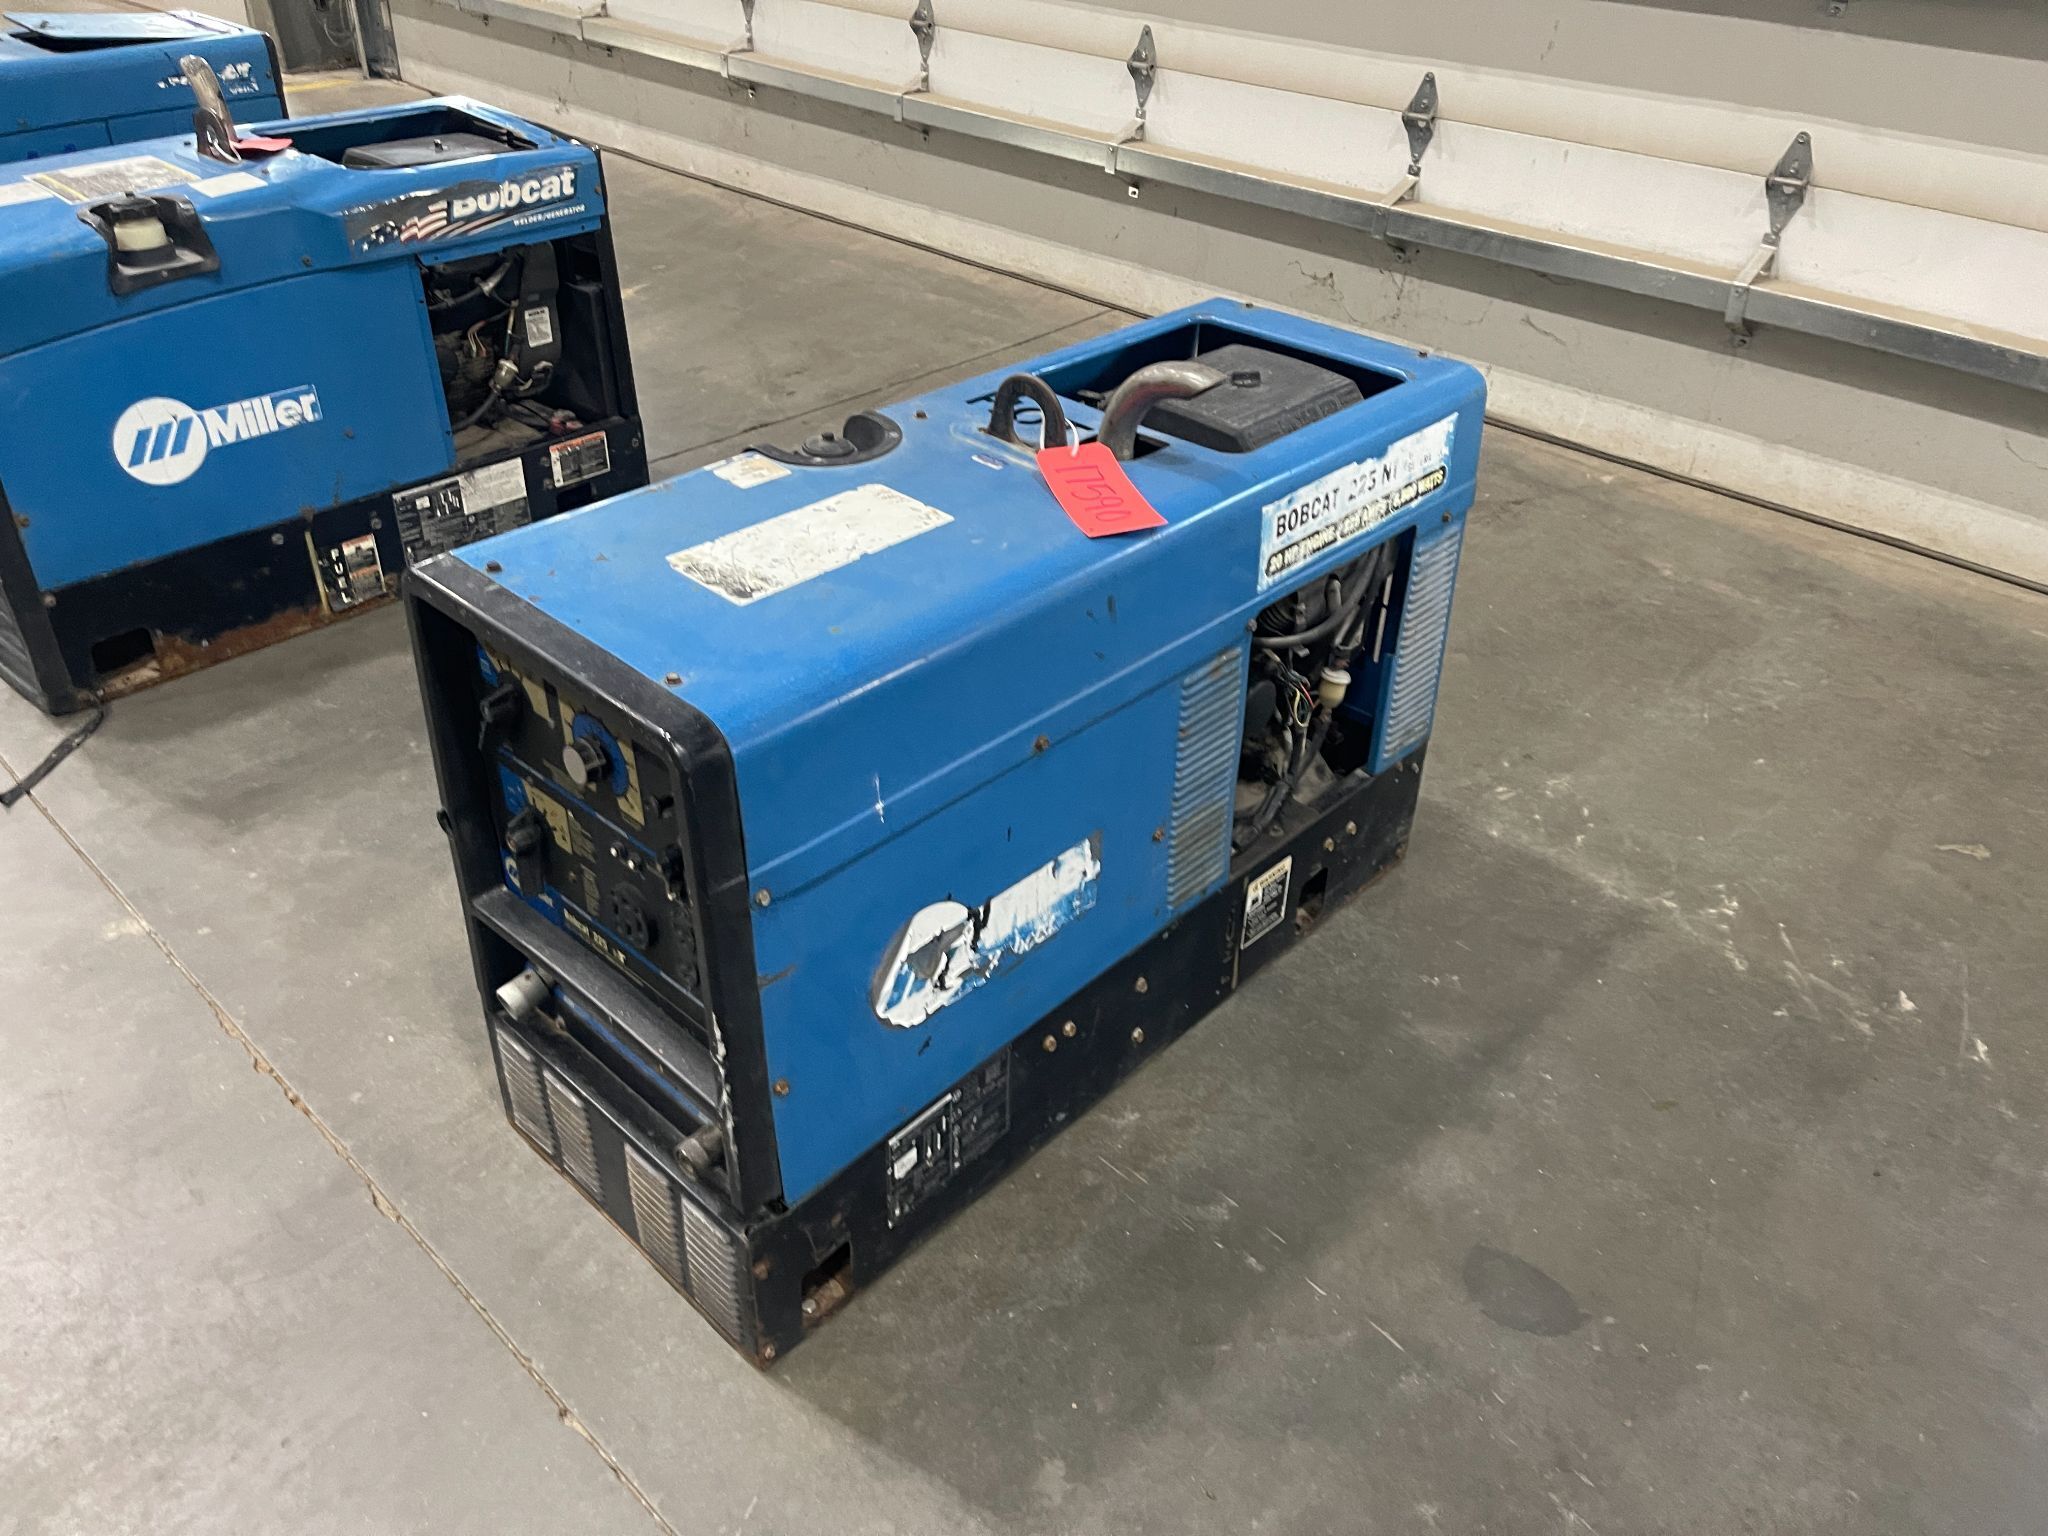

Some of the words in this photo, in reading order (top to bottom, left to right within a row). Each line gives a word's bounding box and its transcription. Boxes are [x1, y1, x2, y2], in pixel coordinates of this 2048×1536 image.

[452, 166, 575, 218] Bobcat
[203, 393, 316, 447] Miller
[1055, 465, 1131, 522] 17590
[1276, 487, 1339, 540] BOBCAT
